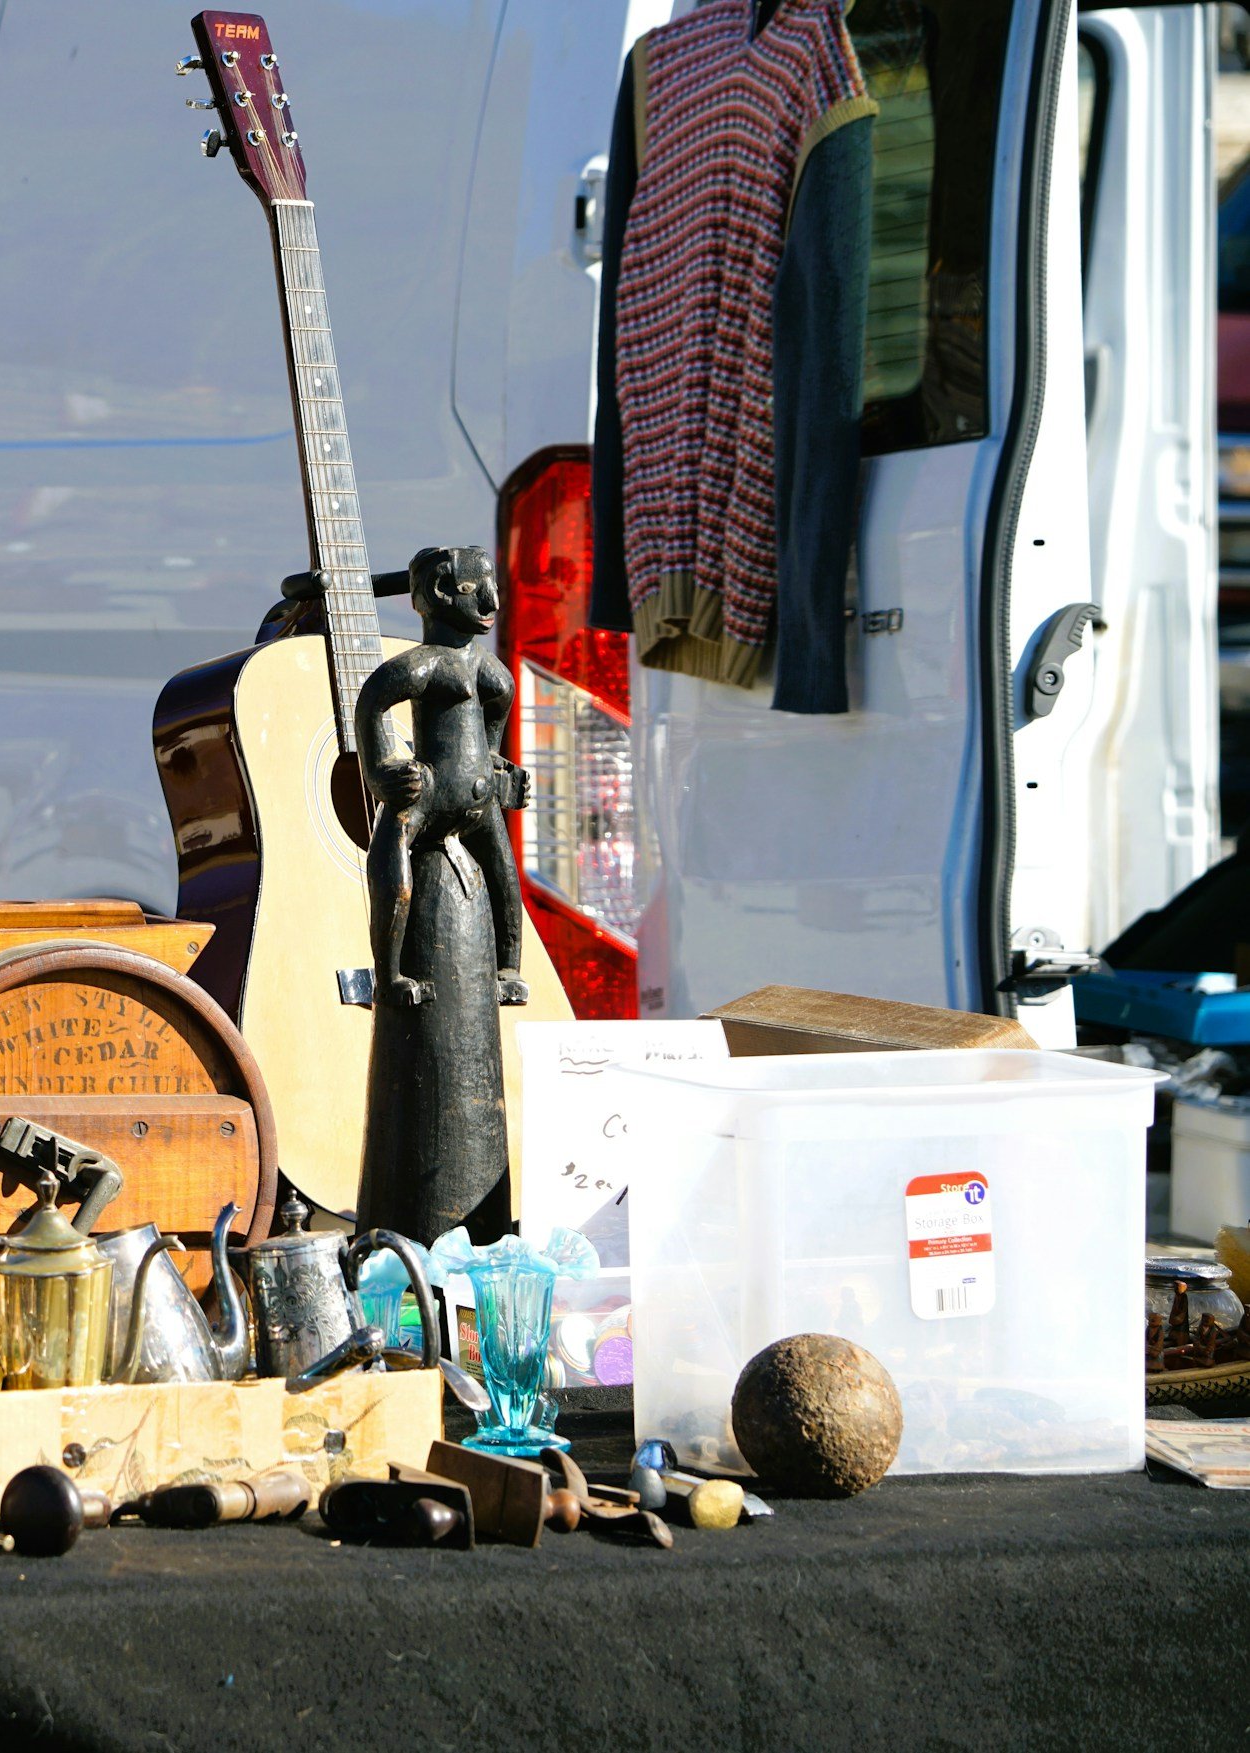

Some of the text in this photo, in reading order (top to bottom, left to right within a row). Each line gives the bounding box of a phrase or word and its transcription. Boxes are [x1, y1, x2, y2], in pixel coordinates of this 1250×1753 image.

[215, 24, 260, 40] TEAM
[76, 990, 172, 1043] STYLE
[53, 1039, 159, 1066] CEDAR
[914, 1213, 984, 1230] Storage Box
[459, 1322, 479, 1344] Stor
